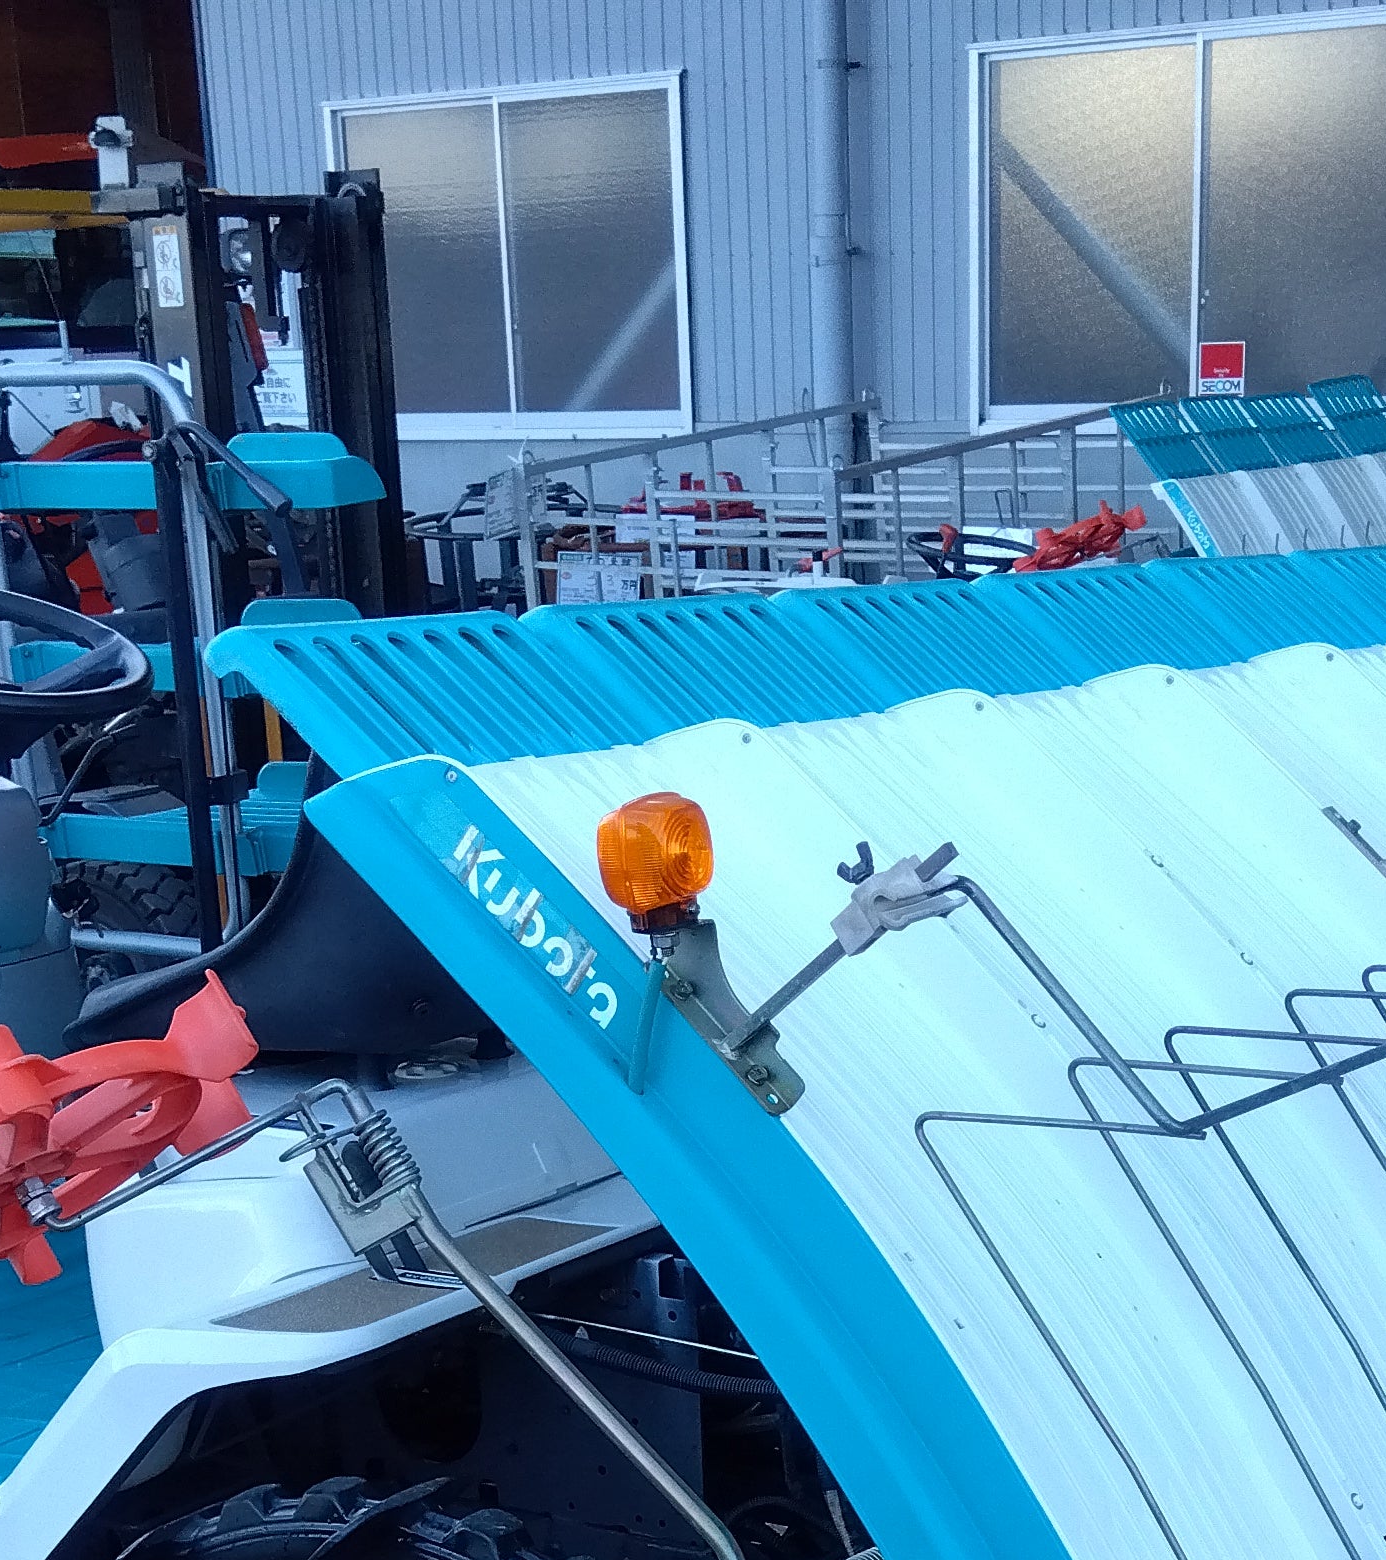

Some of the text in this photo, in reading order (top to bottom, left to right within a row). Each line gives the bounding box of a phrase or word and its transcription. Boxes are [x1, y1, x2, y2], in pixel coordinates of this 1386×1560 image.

[259, 377, 291, 389] 自由に
[1201, 380, 1241, 393] SECOM
[1186, 510, 1211, 550] Kubota
[453, 824, 618, 1030] Kubota
